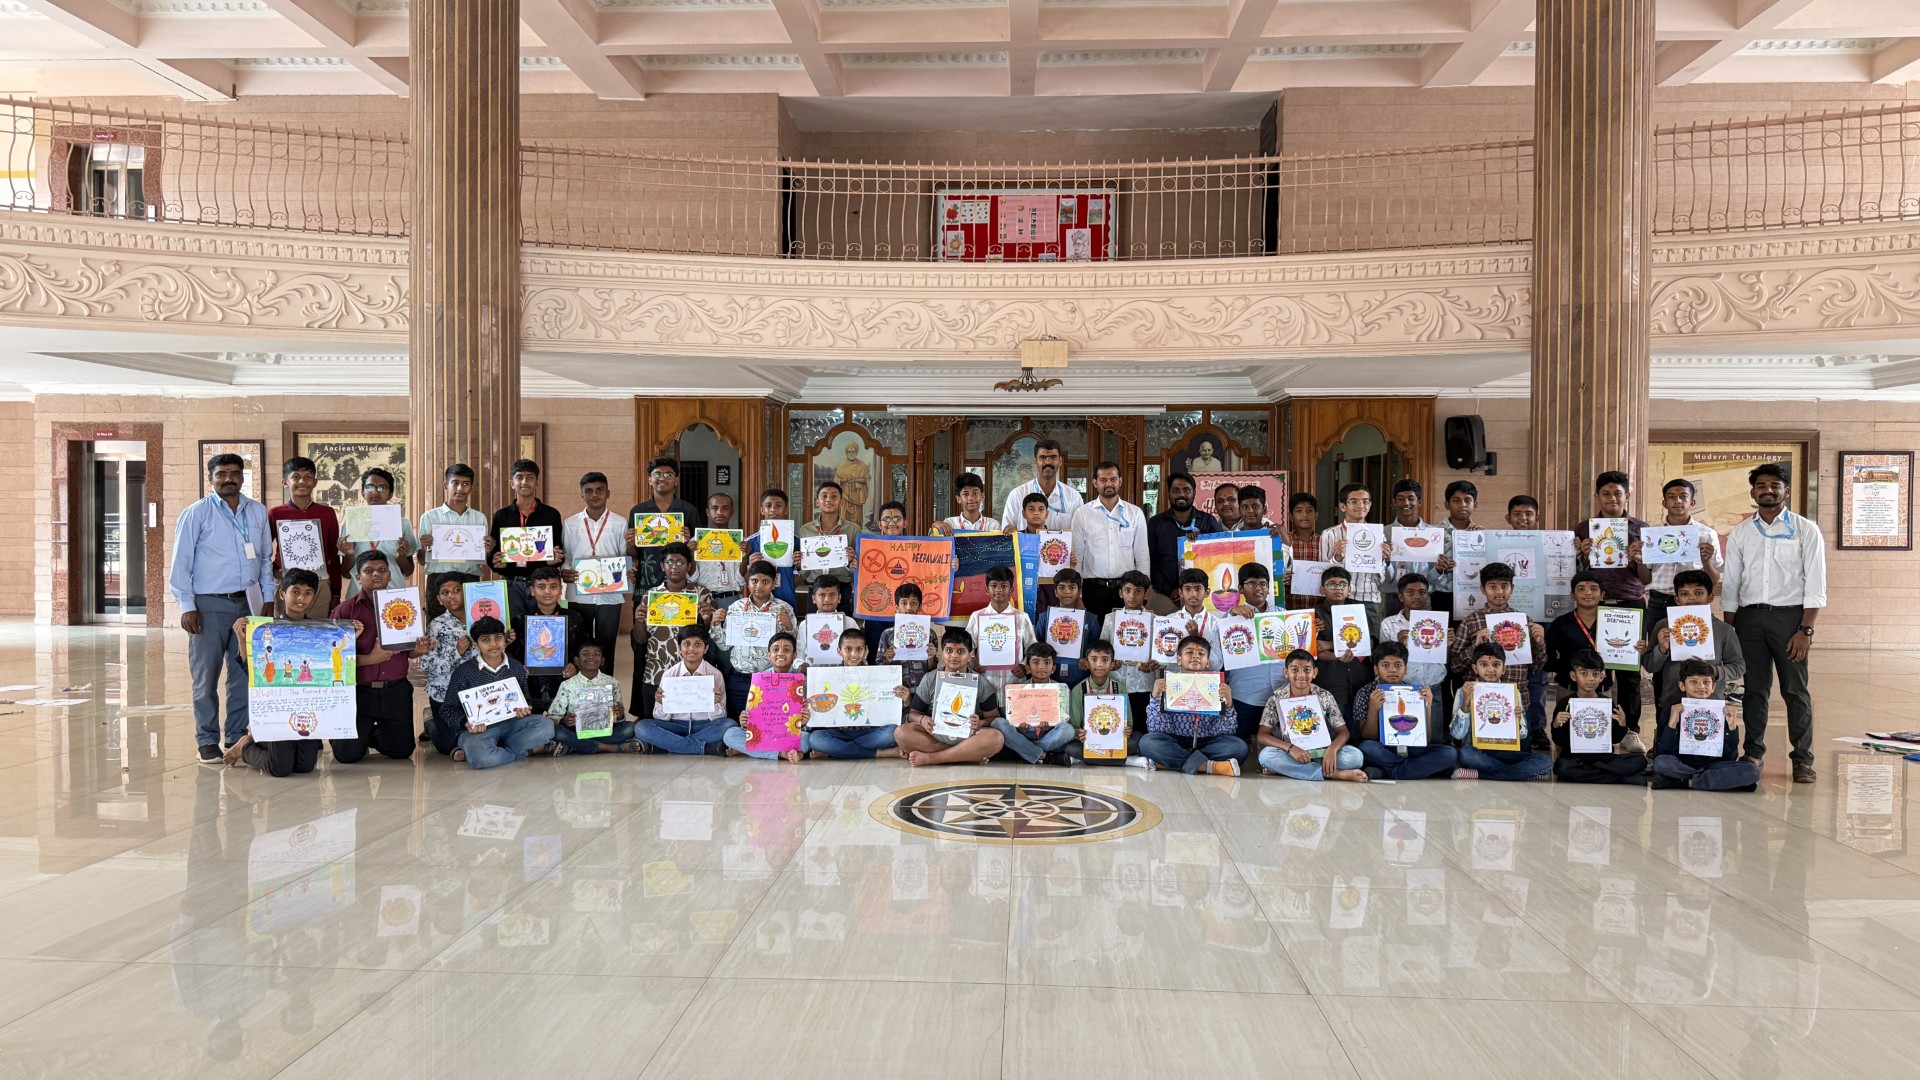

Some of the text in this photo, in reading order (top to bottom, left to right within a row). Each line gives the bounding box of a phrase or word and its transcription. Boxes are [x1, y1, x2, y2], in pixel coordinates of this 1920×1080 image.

[1731, 453, 1782, 463] Technology
[890, 542, 922, 552] HAPPY
[911, 552, 951, 565] DEEPAWALI
[250, 688, 282, 698] DIWALI
[288, 688, 300, 696] The
